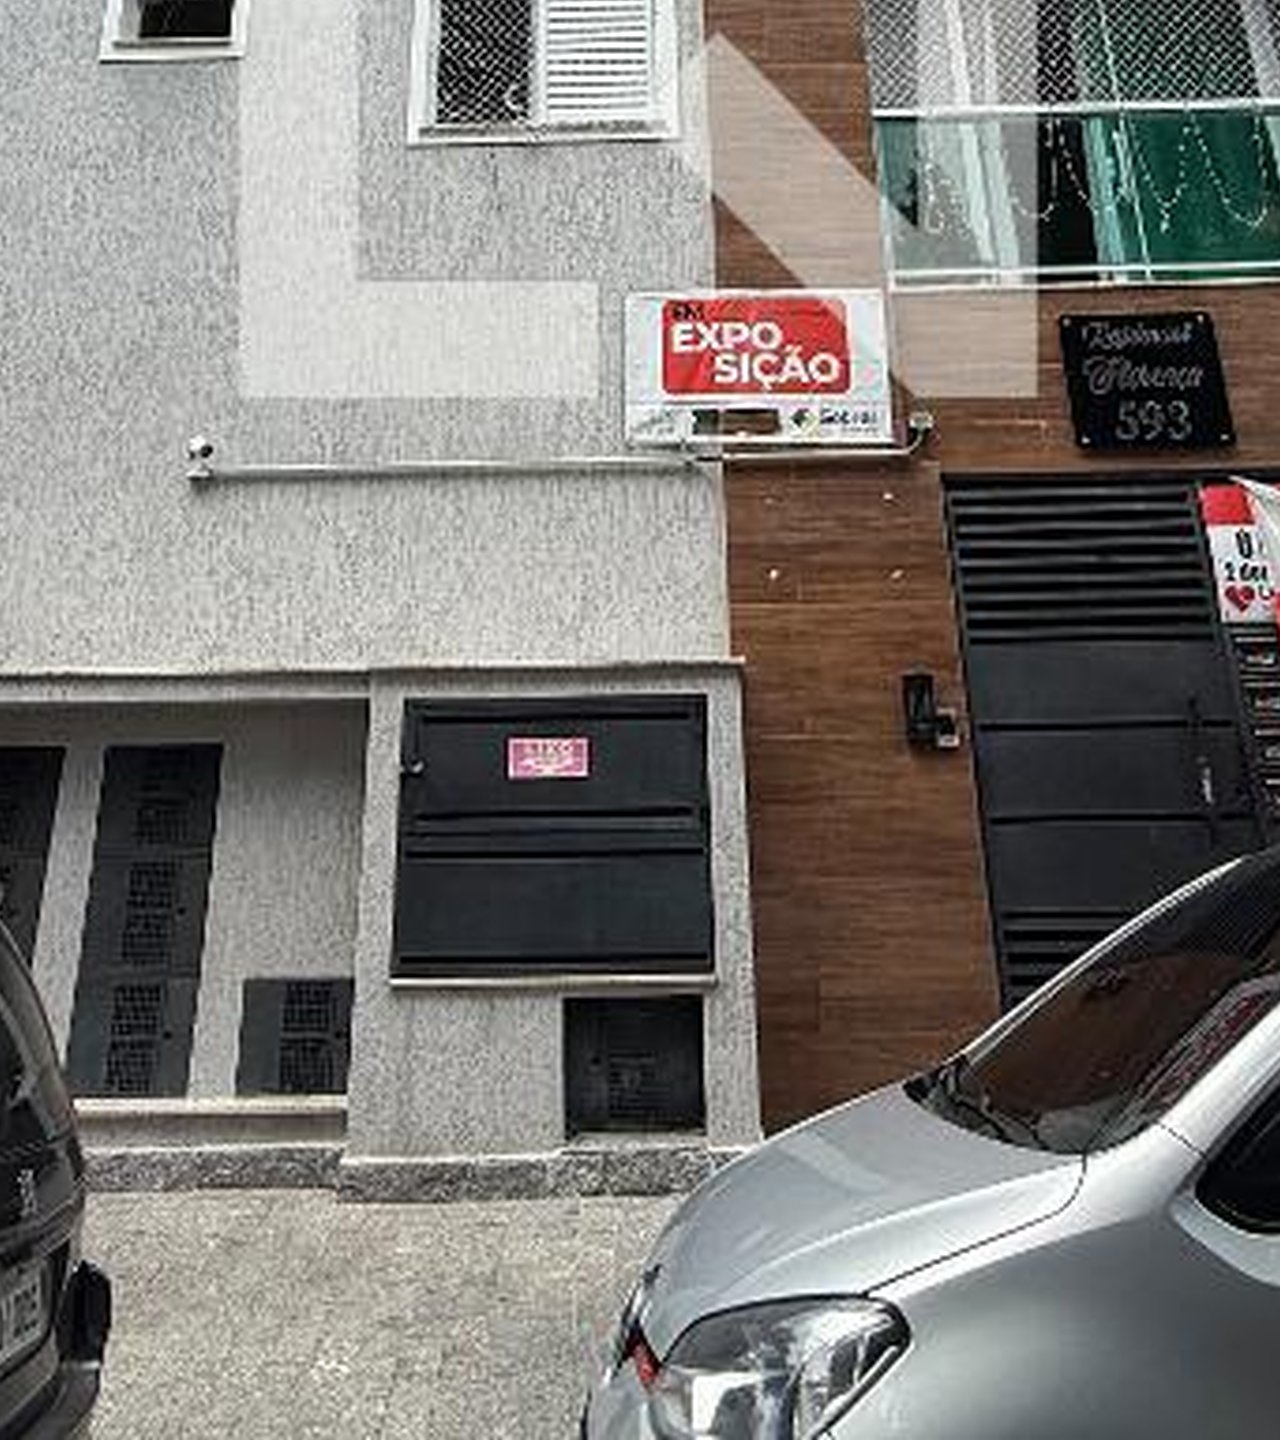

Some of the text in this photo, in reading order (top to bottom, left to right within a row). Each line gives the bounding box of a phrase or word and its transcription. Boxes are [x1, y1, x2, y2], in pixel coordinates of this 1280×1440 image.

[672, 321, 783, 353] EXPO
[714, 345, 840, 390] SIÇÃO
[1115, 400, 1193, 441] 593
